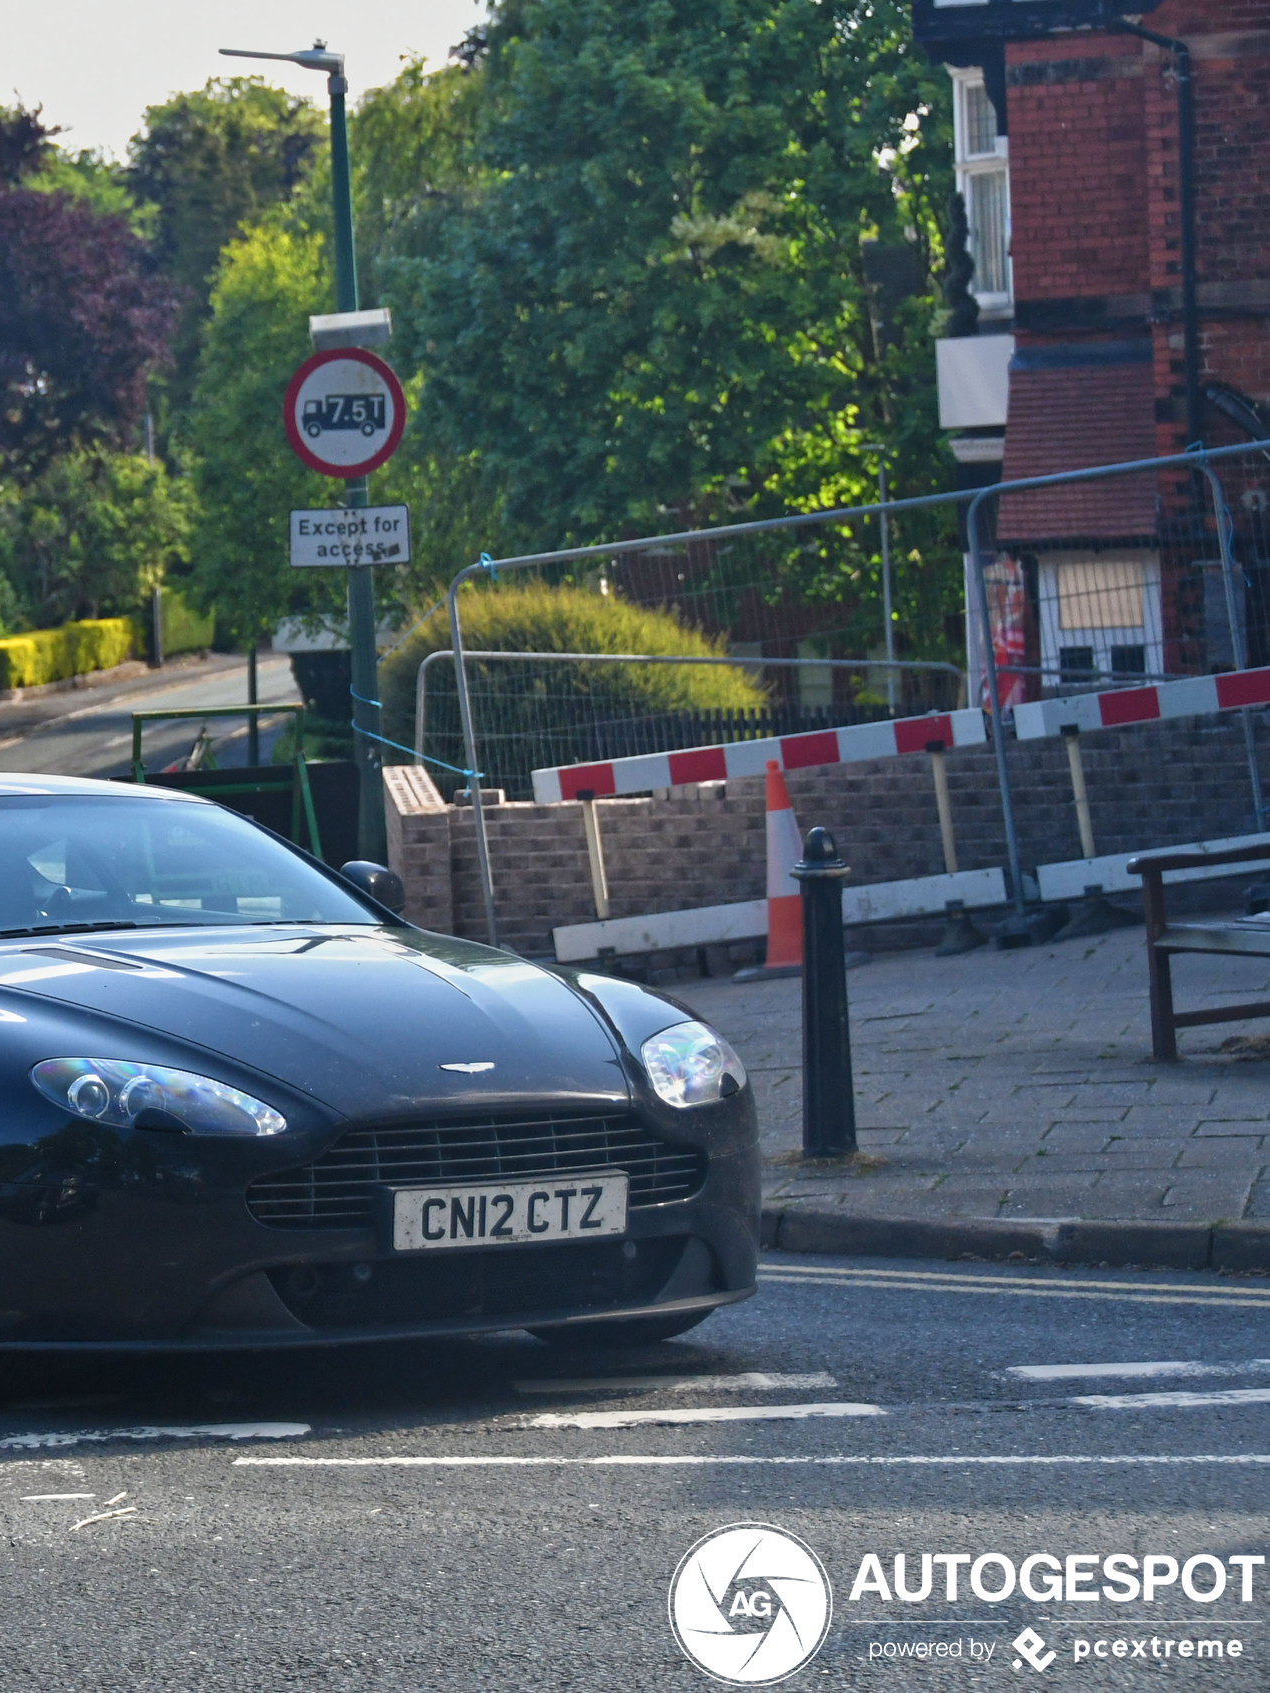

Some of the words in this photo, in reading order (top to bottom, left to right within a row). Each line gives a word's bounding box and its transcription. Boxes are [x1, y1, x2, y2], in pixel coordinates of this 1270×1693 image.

[330, 396, 383, 423] 7.5T
[298, 518, 368, 537] Except
[374, 517, 400, 533] for
[422, 1194, 514, 1240] CN12
[527, 1186, 603, 1233] CTZ
